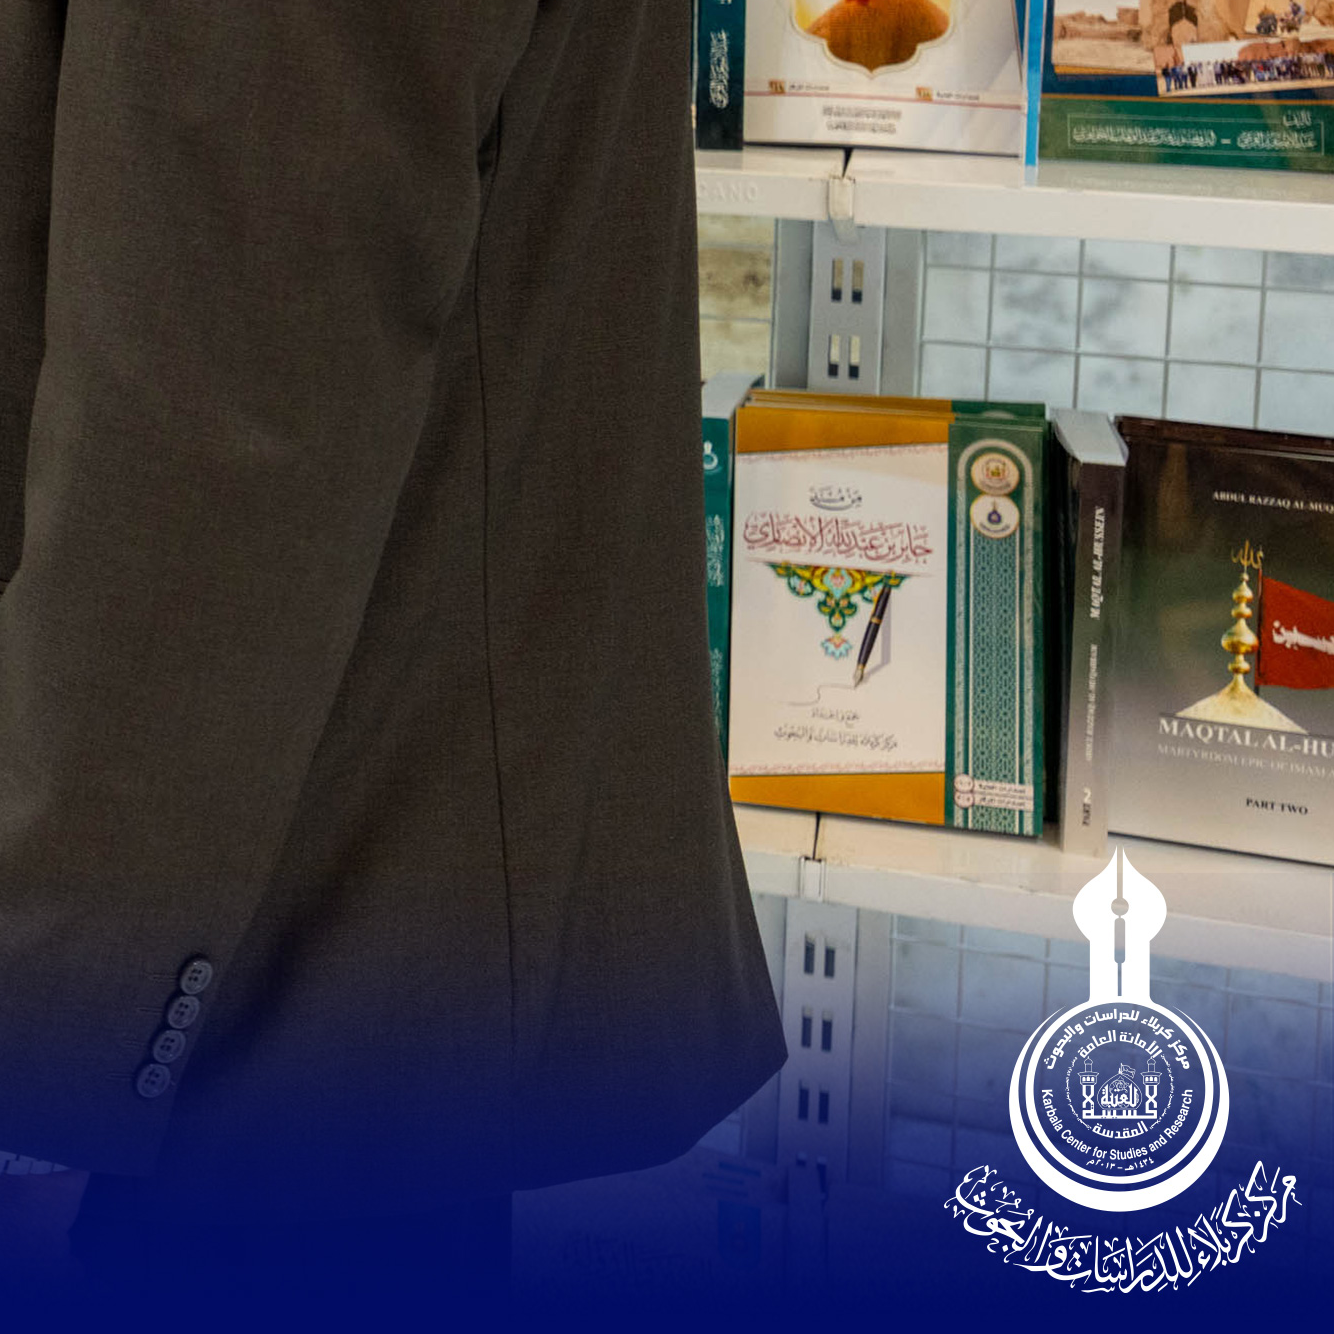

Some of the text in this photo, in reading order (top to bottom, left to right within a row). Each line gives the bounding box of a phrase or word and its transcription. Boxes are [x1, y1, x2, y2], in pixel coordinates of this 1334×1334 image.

[1213, 491, 1249, 504] ABDUL
[1249, 494, 1291, 509] RAZZAQ
[1159, 716, 1261, 750] MAQTAL
[1246, 797, 1309, 816] PART TWO
